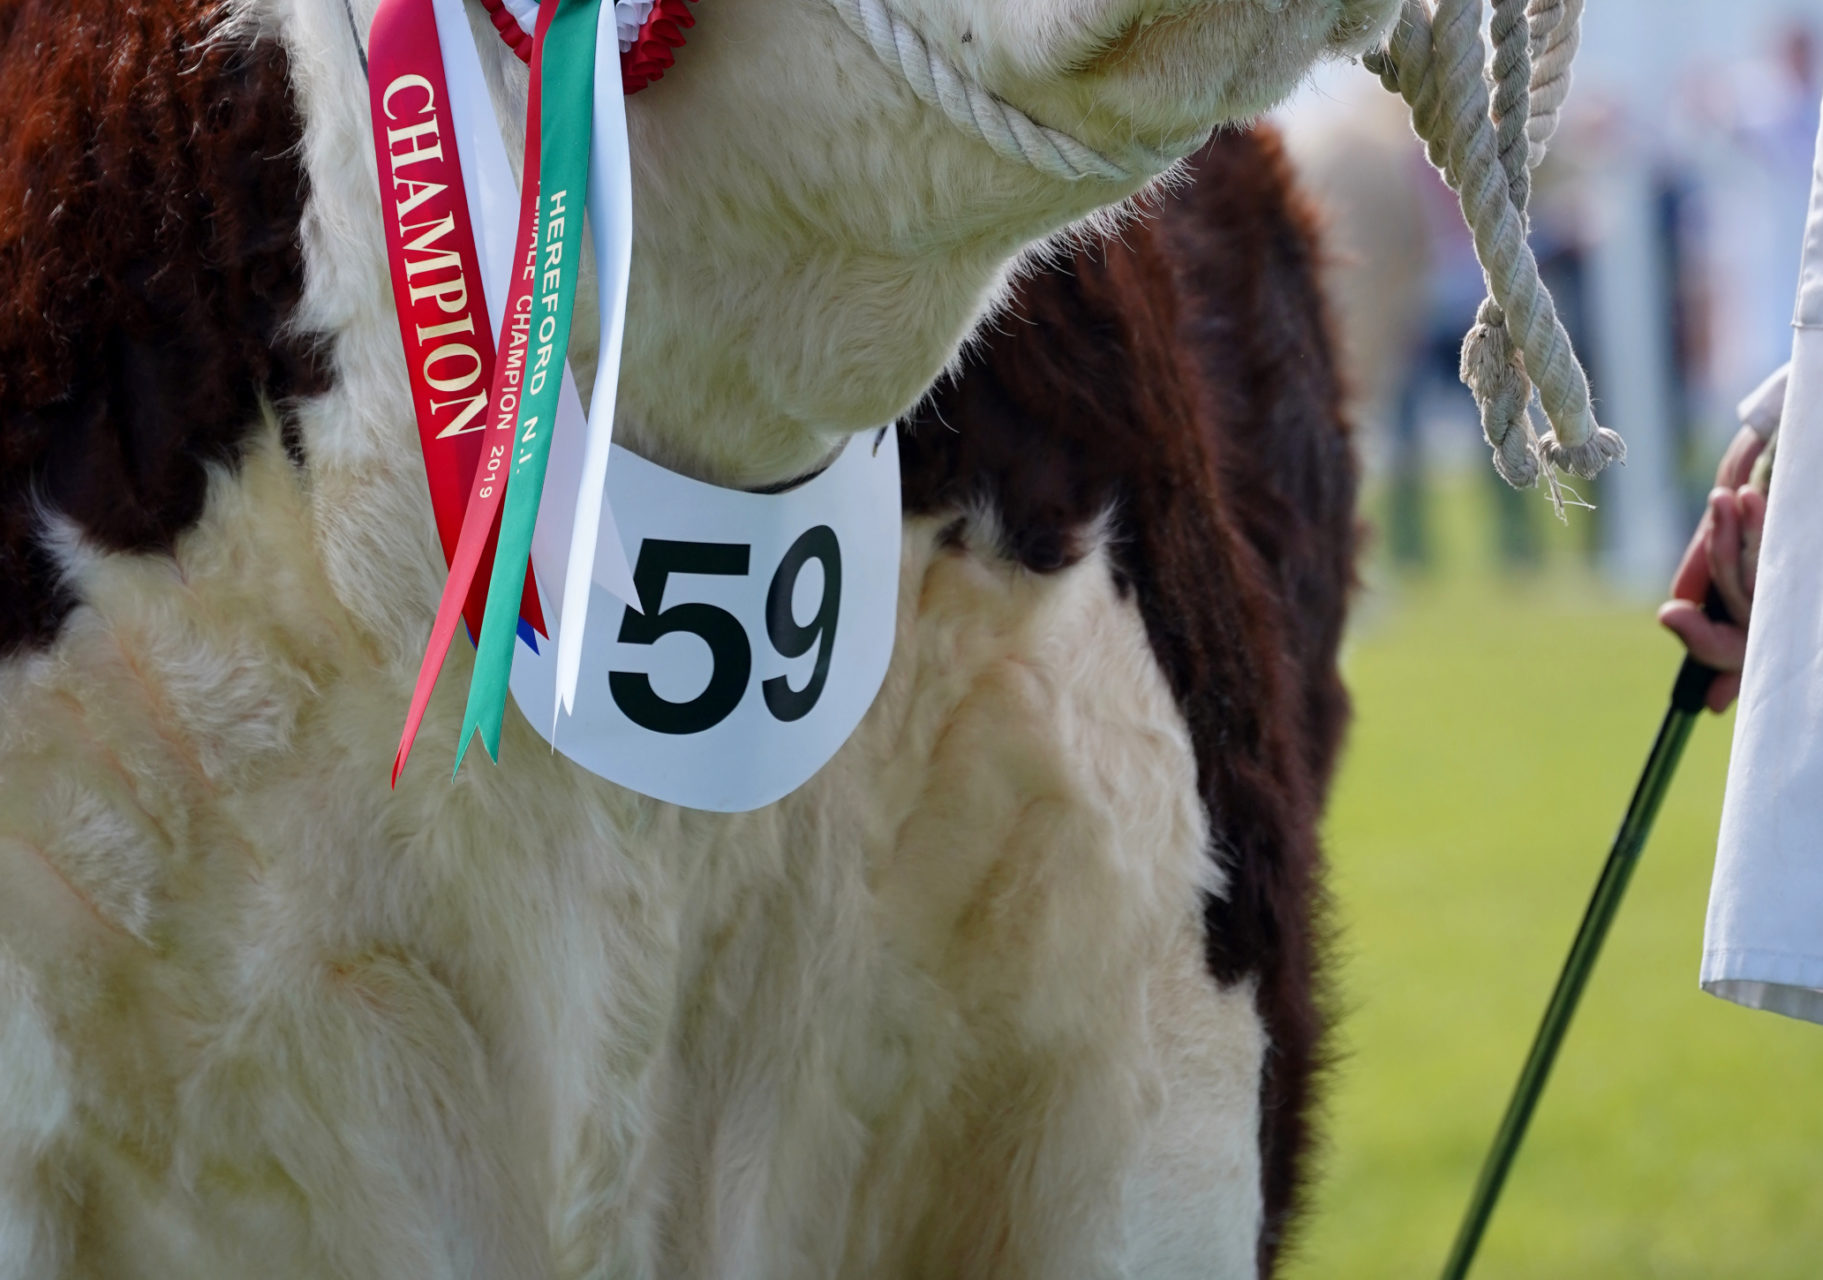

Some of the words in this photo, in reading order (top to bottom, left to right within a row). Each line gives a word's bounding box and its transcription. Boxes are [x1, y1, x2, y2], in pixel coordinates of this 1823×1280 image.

[383, 73, 489, 440] CHAMPION
[529, 189, 567, 396] HEREFORD
[496, 295, 533, 430] CHAMPION
[516, 415, 539, 475] N.I.
[479, 445, 504, 499] 2019
[608, 524, 842, 735] 59
